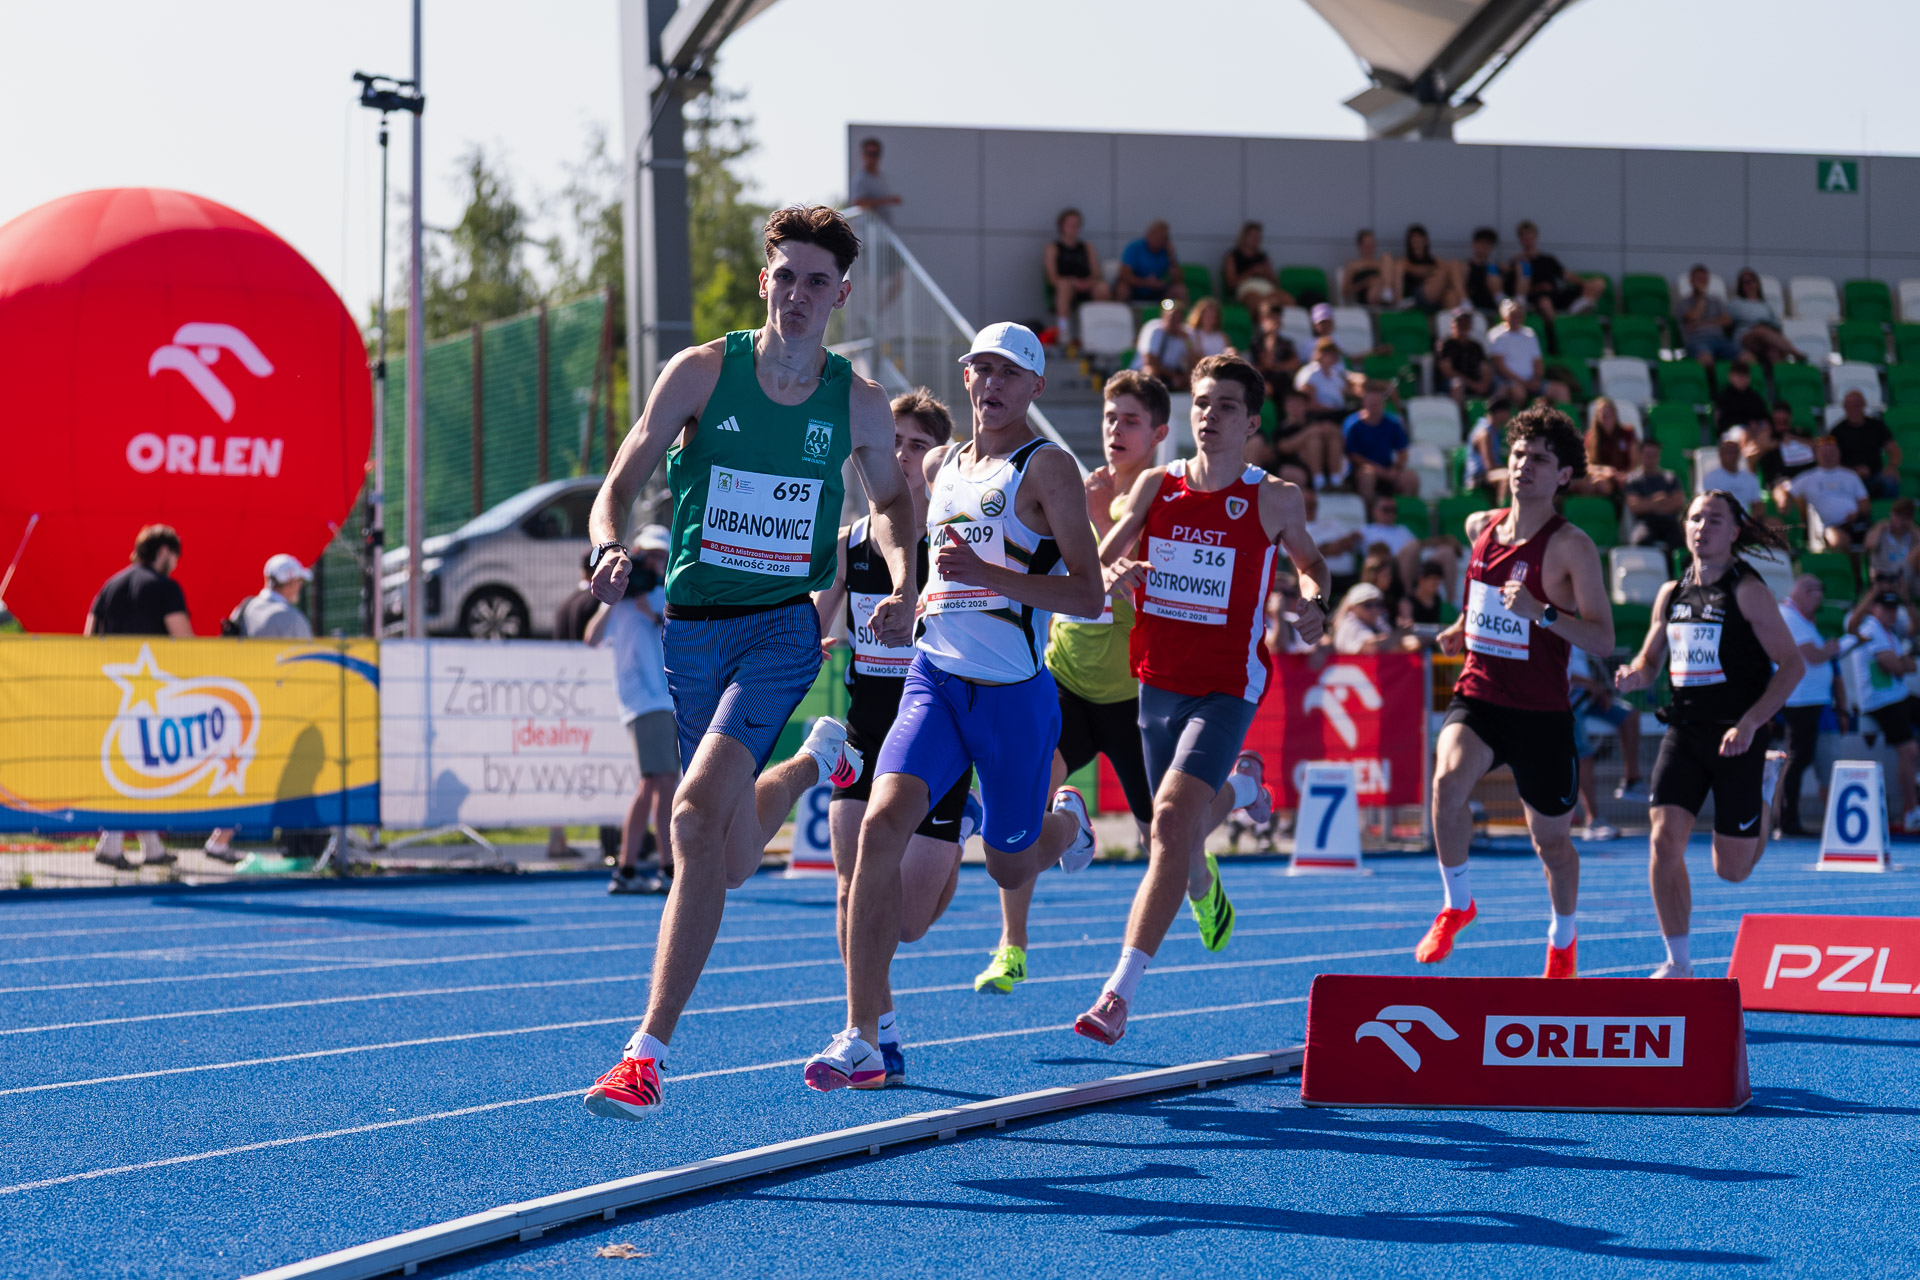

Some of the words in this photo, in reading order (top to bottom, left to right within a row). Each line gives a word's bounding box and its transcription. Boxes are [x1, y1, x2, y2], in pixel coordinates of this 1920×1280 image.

[1826, 161, 1849, 191] A
[126, 432, 284, 478] ORLEN
[773, 482, 811, 502] 695
[708, 506, 811, 541] URBANOWICZ
[963, 525, 994, 544] 209
[1171, 525, 1227, 546] PIAST
[720, 545, 735, 553] PZLA
[736, 548, 774, 559] Mistrzostwa
[775, 553, 792, 561] Polski
[720, 555, 765, 570] ZAMOŚĆ
[766, 563, 791, 573] 2026
[1192, 549, 1226, 567] 516
[853, 562, 869, 571] esa
[1149, 570, 1226, 598] OSTROWSKI
[937, 599, 967, 610] ZAMOŚĆ
[968, 600, 988, 608] 2026
[1157, 607, 1187, 618] ZAMOŚĆ
[1188, 612, 1208, 622] 2026
[1470, 610, 1522, 636] DOŁĘGA
[1693, 627, 1715, 641] 373
[866, 665, 898, 675] ZAMOŚĆ
[138, 706, 224, 766] LOTTO
[484, 753, 521, 796] by
[807, 786, 833, 851] 8
[1309, 785, 1347, 849] 7
[1837, 784, 1869, 845] 6
[1763, 944, 1920, 994] PZL
[1494, 1022, 1672, 1059] ORLEN
